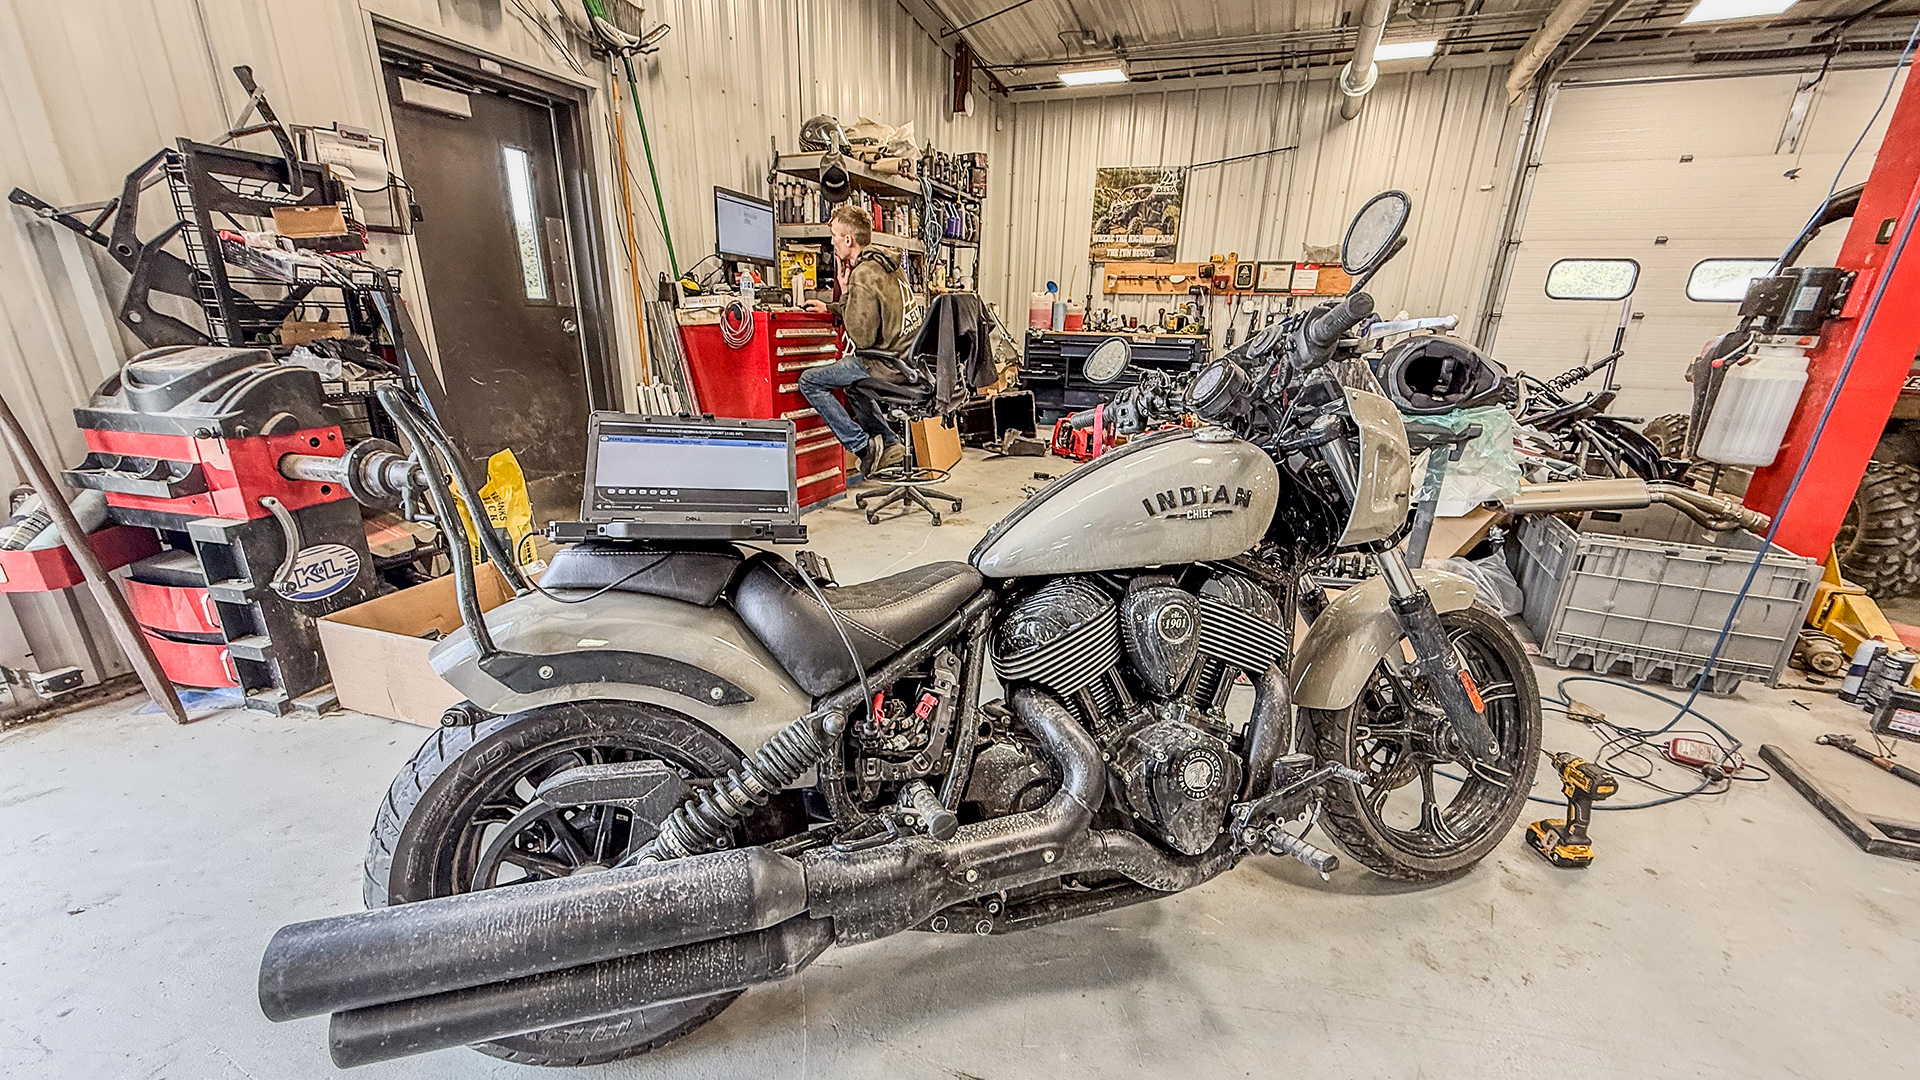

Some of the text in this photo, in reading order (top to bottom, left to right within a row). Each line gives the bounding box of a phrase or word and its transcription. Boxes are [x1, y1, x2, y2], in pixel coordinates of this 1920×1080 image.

[1142, 484, 1253, 517] INDIAN
[1186, 508, 1214, 520] CHIEF
[1165, 618, 1186, 629] 1901
[1189, 751, 1221, 787] MOTORCYCLE
